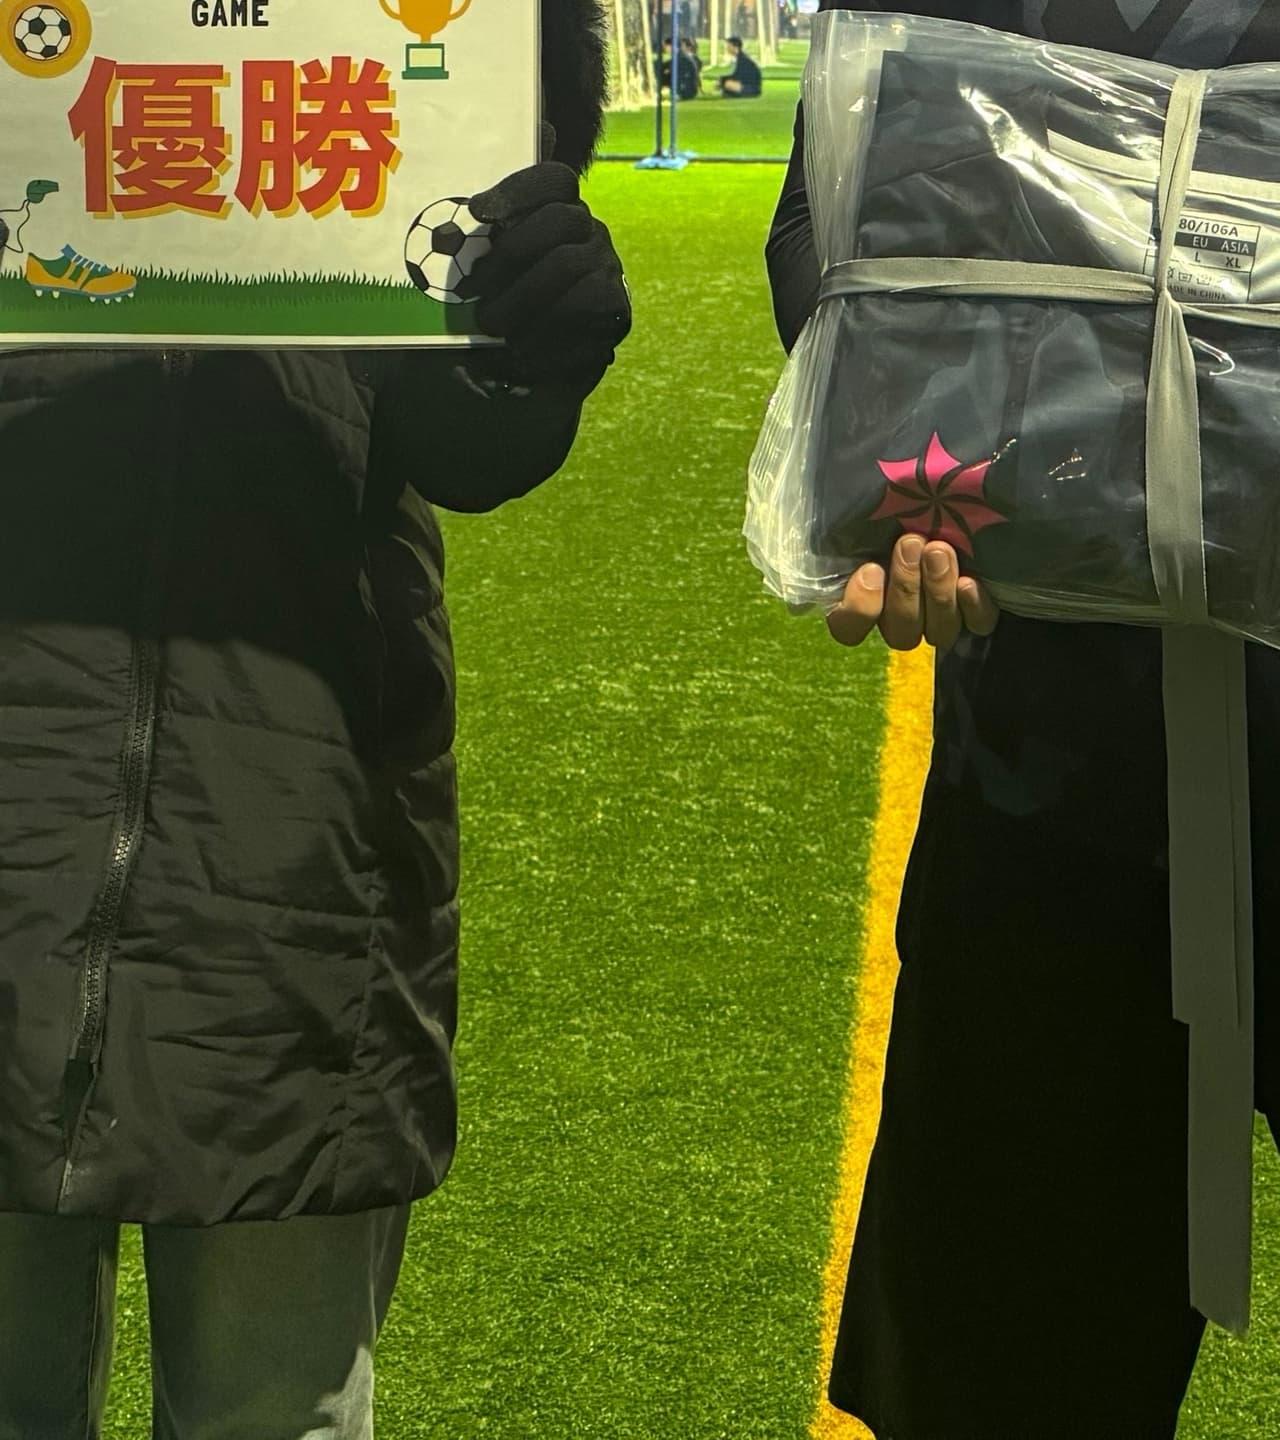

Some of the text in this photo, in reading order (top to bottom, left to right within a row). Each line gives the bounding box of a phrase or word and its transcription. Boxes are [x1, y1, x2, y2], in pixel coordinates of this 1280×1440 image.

[190, 0, 270, 28] GAME
[67, 55, 404, 219] 優勝
[1178, 218, 1238, 237] 80/106A
[1192, 236, 1250, 254] EU ASIA
[1194, 252, 1241, 269] L XL
